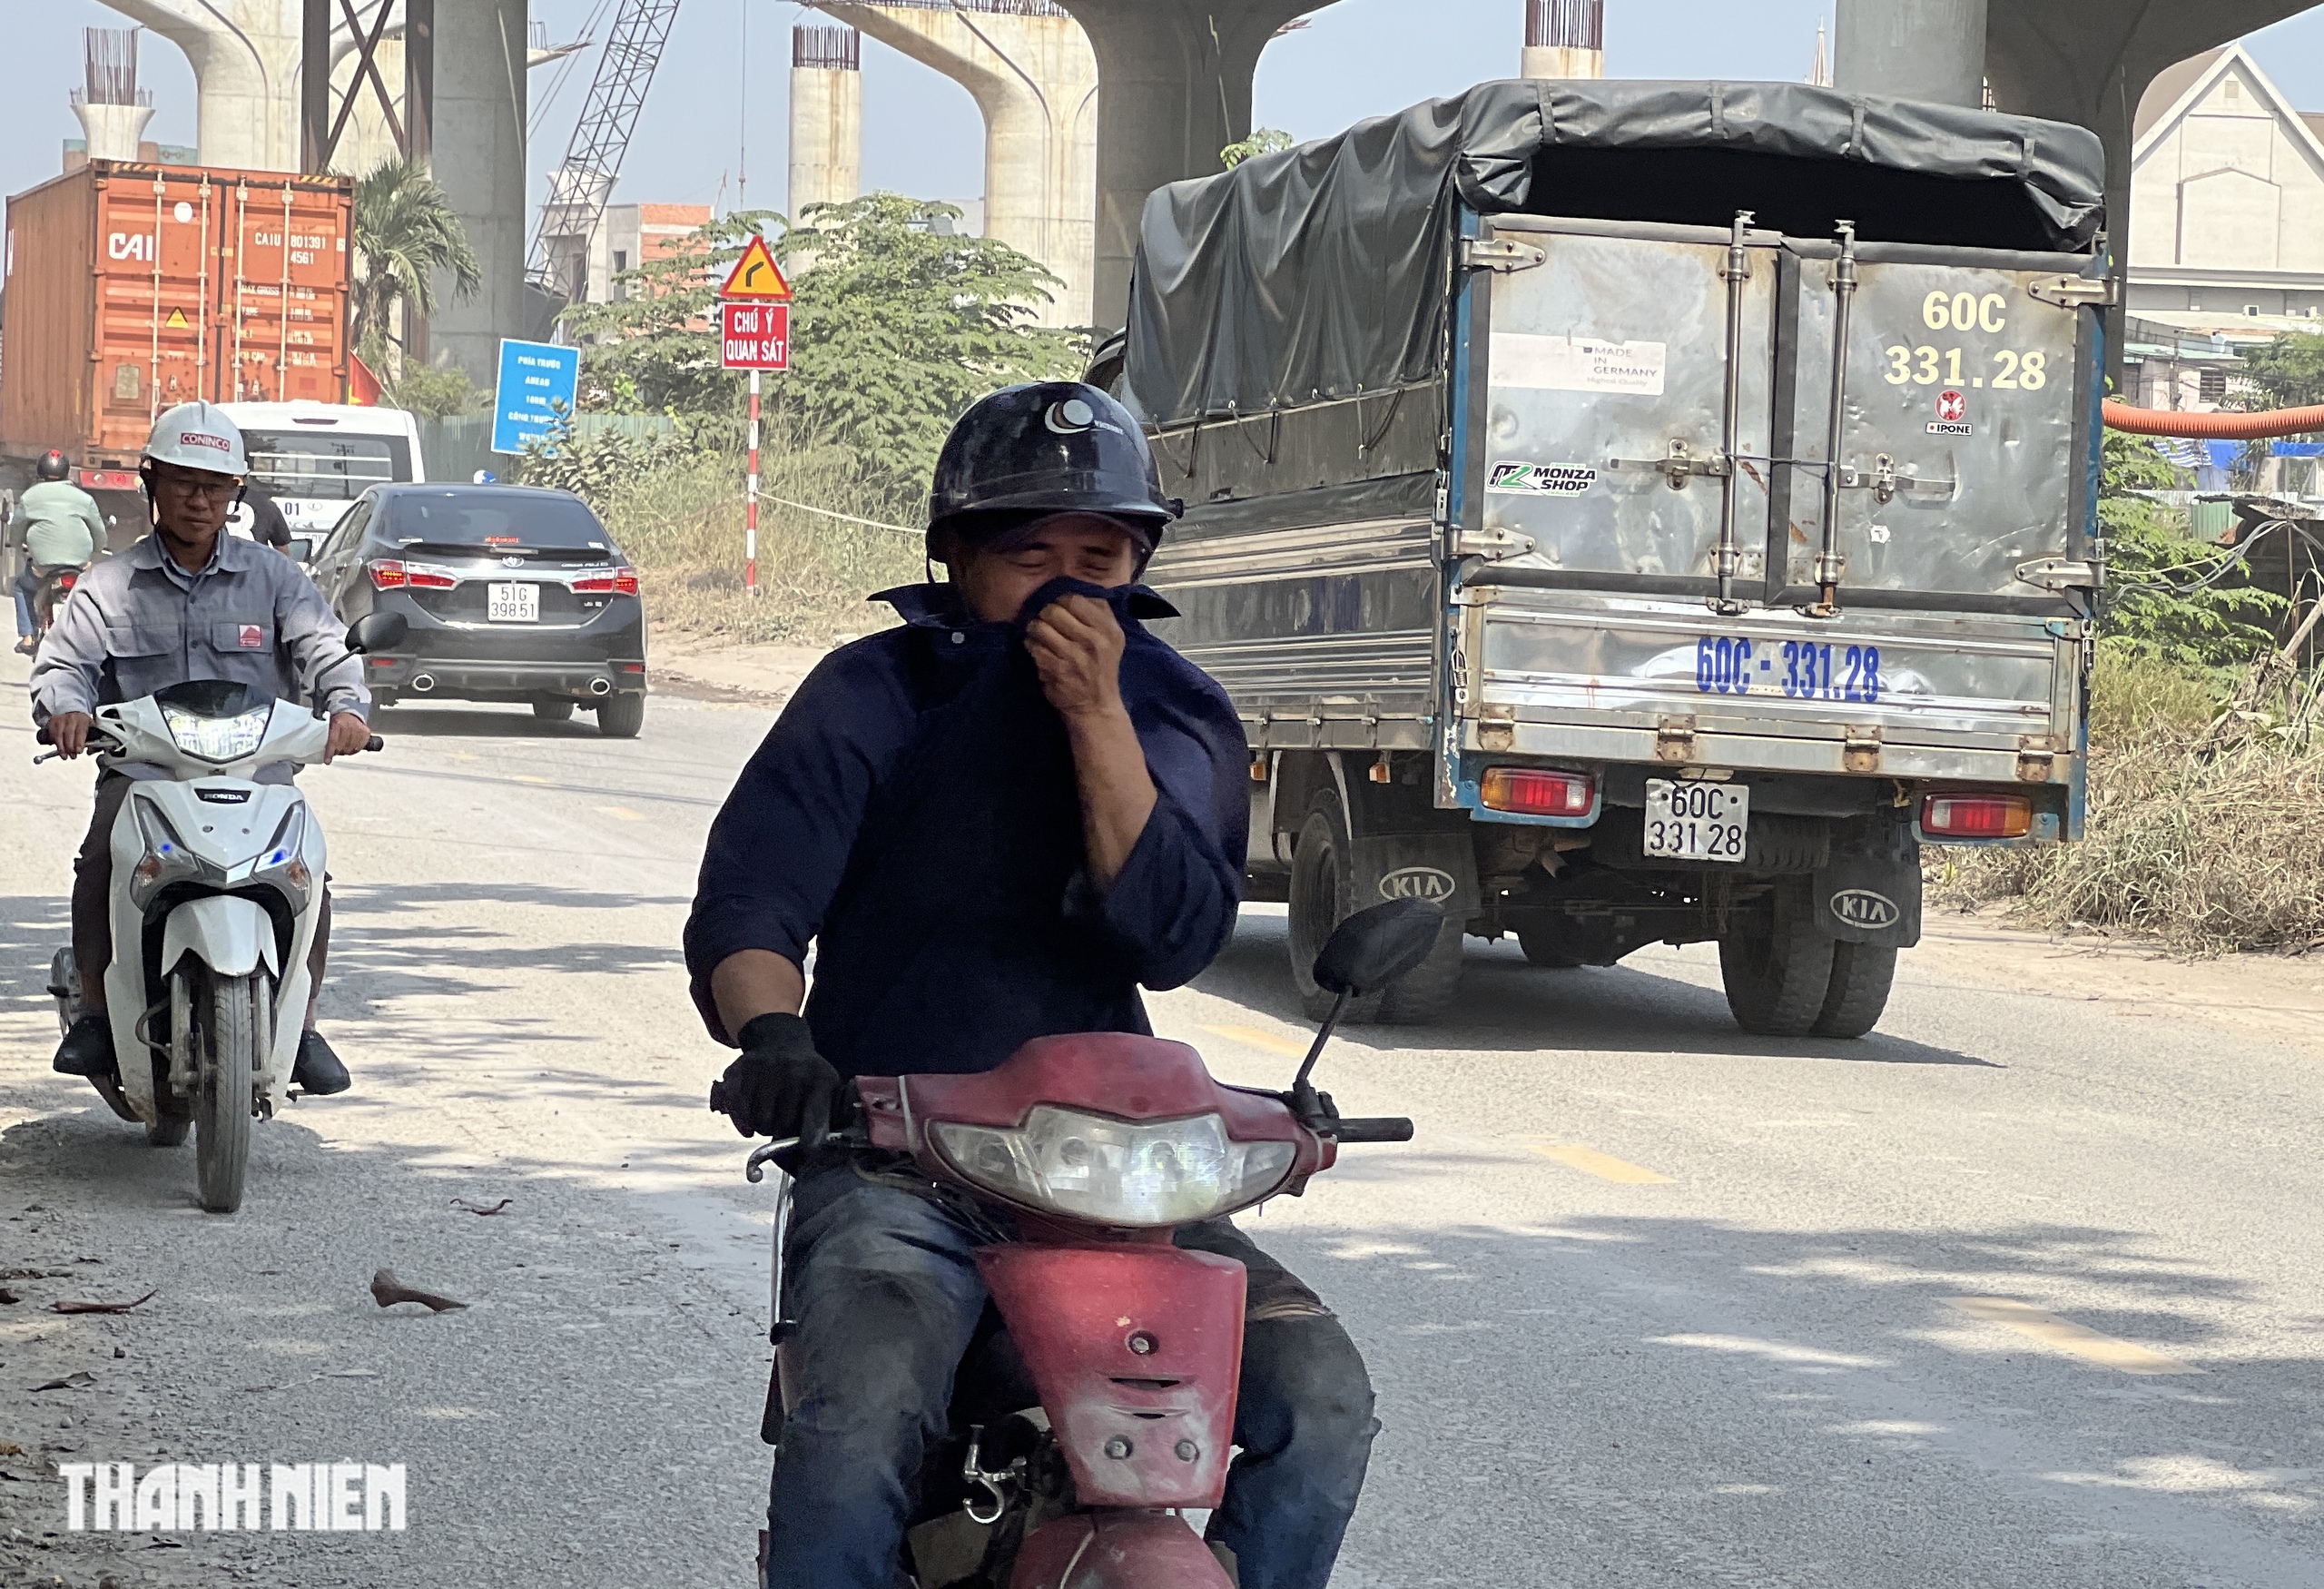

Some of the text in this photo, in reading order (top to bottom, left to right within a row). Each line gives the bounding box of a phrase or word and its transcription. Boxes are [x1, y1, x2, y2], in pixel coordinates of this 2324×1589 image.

[109, 232, 153, 262] CAI
[255, 232, 281, 247] CAIU
[290, 234, 326, 251] 801391
[290, 251, 314, 264] 4561
[734, 307, 774, 334] CHÚ Ý
[1922, 290, 2006, 333] 60C
[726, 335, 784, 362] QUAN SÁT
[1594, 347, 1633, 358] MADE
[1594, 356, 1607, 365] IN
[1884, 345, 2046, 390] 331.28
[1593, 366, 1658, 377] GERMANY
[1936, 424, 1970, 434] IPONE
[182, 433, 230, 450] CONINCO
[1533, 467, 1596, 480] MONZA
[1540, 479, 1589, 491] SHOP
[501, 586, 527, 602] 51G
[1696, 637, 1752, 695] 60C
[1781, 639, 1879, 703] 331.28
[203, 793, 244, 801] HONDA
[1671, 786, 1724, 819] 60C
[1392, 875, 1444, 897] KIA
[1842, 895, 1887, 922] KIA
